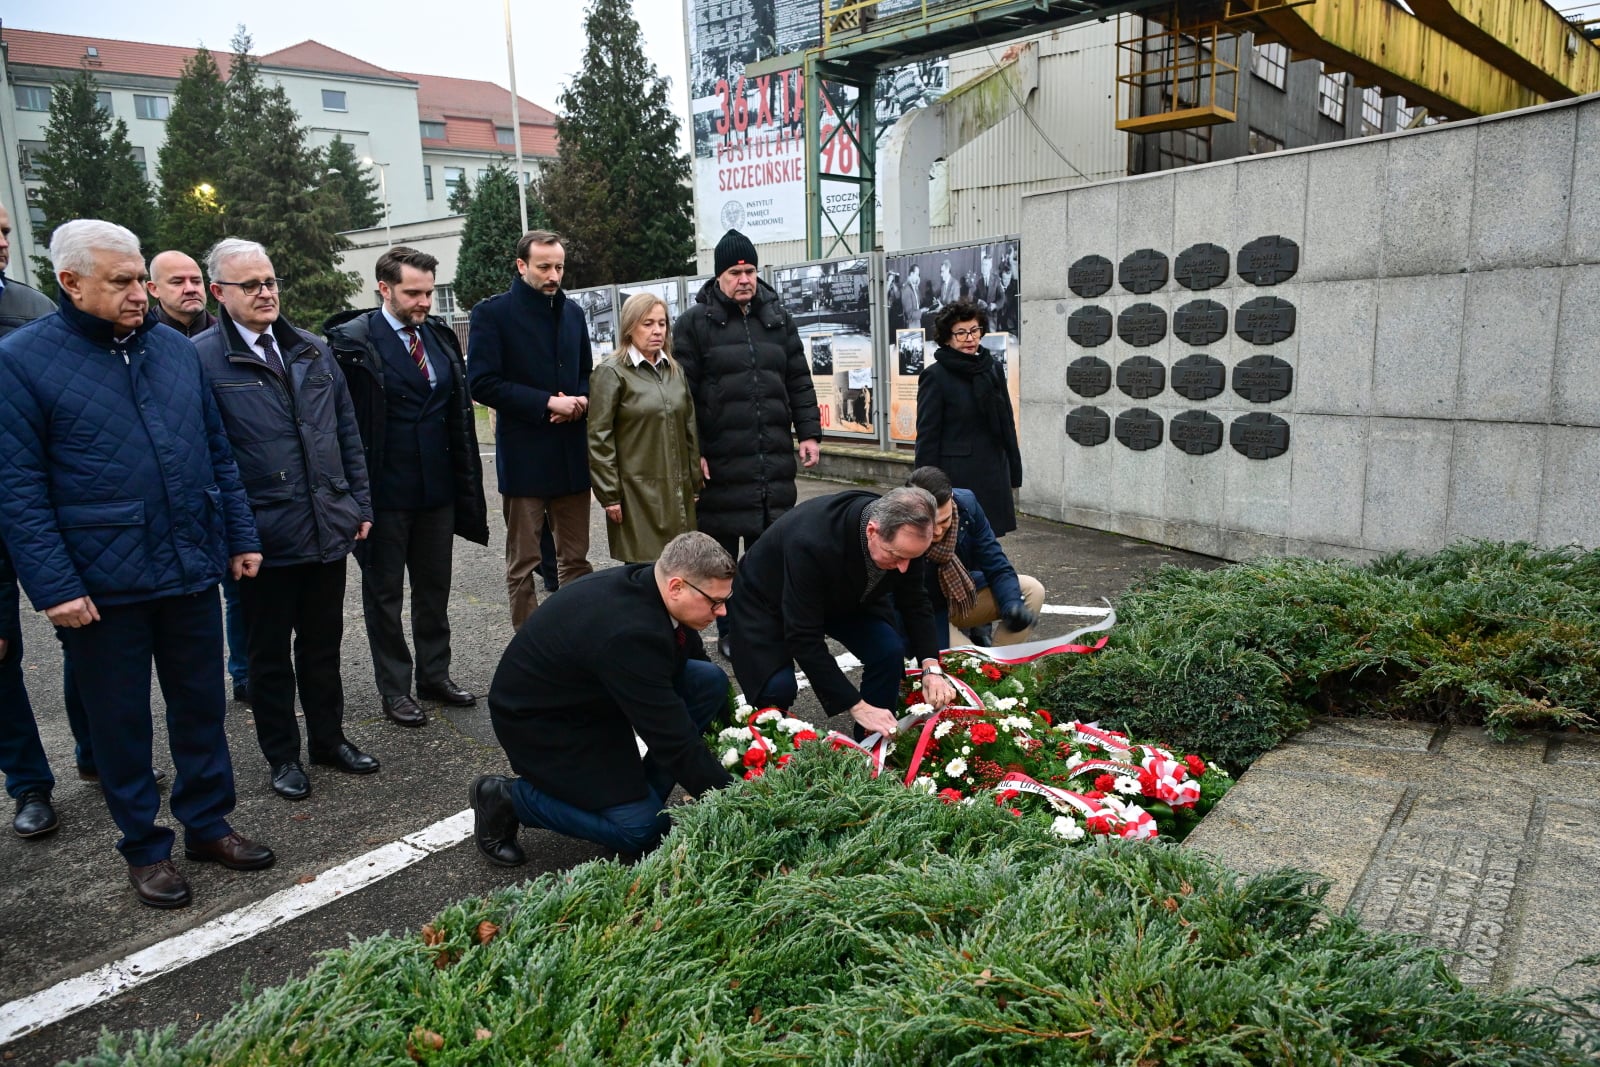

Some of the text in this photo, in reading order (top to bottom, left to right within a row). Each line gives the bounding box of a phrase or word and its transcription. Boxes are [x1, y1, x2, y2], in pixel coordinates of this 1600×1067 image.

[715, 75, 749, 136] 36
[716, 129, 801, 165] POSTULATY
[718, 157, 803, 192] SZCZECIŃSKIE
[746, 199, 774, 208] INSTYTUT
[746, 209, 770, 218] PAMIĘCI
[746, 216, 784, 226] NARODOWEJ
